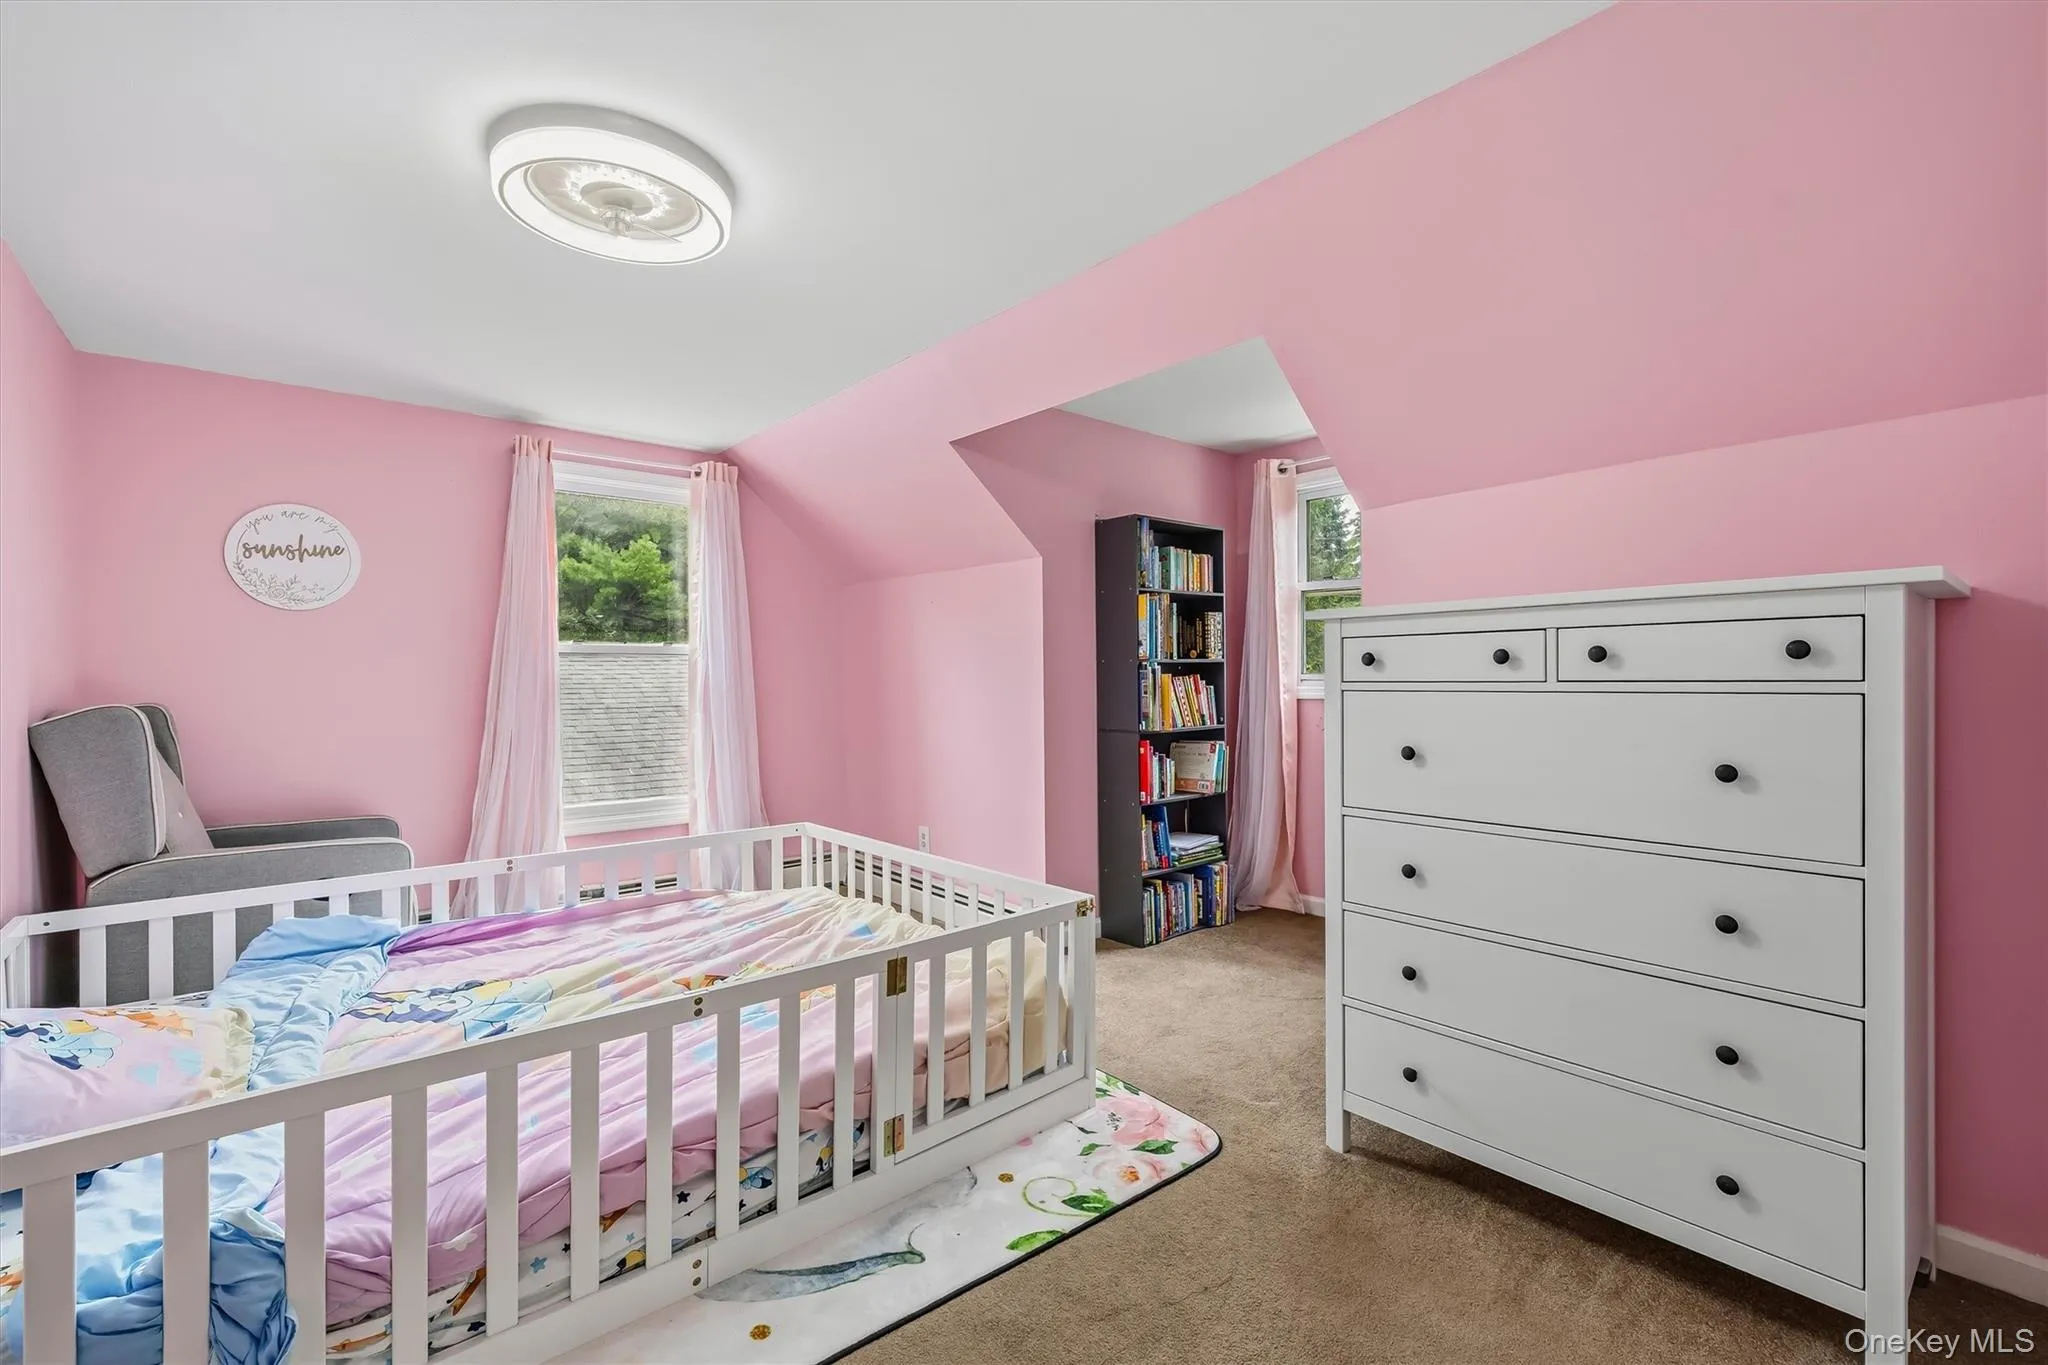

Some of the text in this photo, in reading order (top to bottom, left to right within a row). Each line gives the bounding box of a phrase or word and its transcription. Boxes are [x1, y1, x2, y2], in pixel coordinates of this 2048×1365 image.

[245, 510, 340, 535] you are my
[242, 534, 345, 563] sunshine
